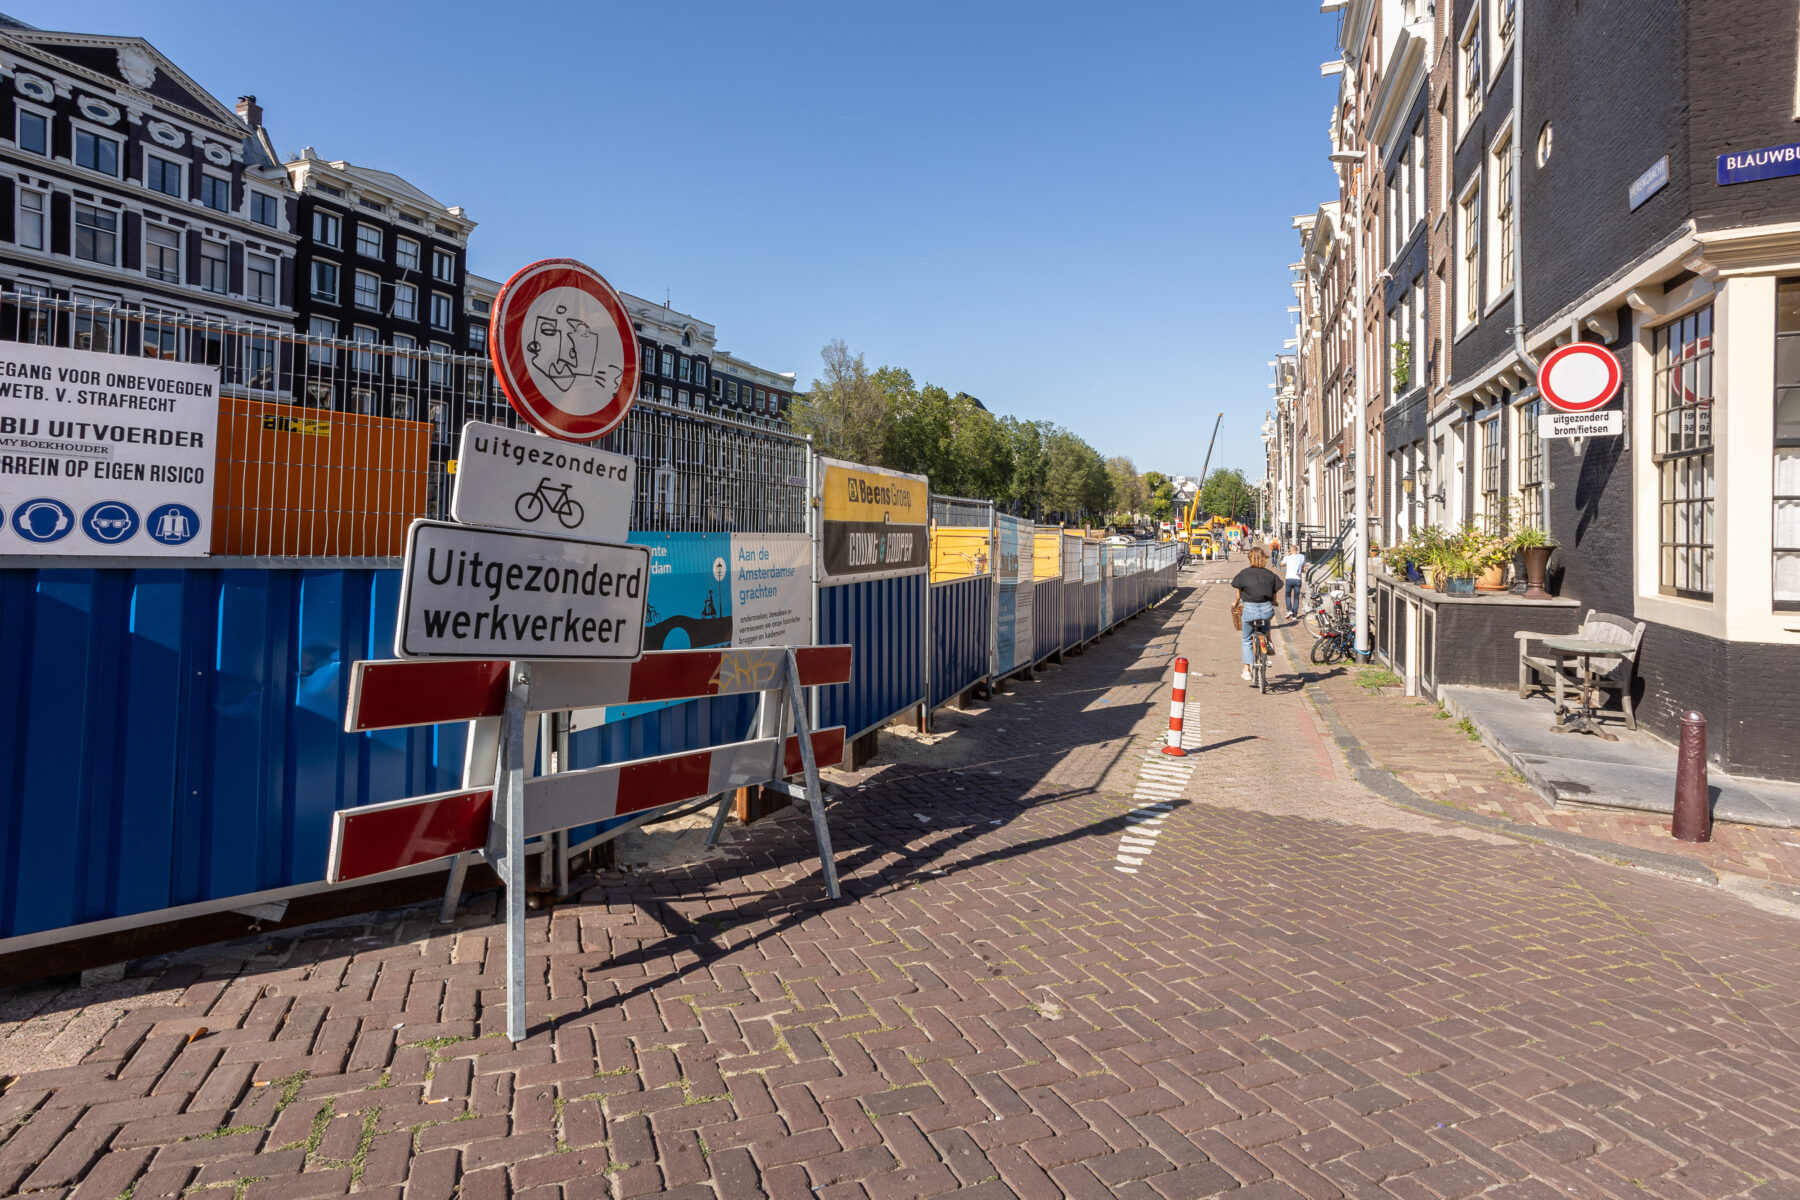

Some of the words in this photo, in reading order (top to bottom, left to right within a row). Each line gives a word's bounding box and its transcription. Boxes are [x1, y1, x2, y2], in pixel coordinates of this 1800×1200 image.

[1726, 146, 1800, 170] BLAUWB
[58, 367, 100, 386] VOOR
[106, 373, 213, 398] ONBEVOEGDEN
[0, 382, 49, 401] WETB.
[77, 390, 177, 413] STRAFRECHT
[0, 416, 39, 436] BIJ
[48, 420, 204, 448] UITVOERDER
[1553, 412, 1609, 425] uitgezonderd
[20, 440, 109, 454] BOEKHOUDER
[474, 436, 628, 482] uitgezonderd
[1, 455, 59, 476] RREIN
[65, 459, 89, 478] OP
[94, 461, 145, 481] EIGEN
[150, 464, 204, 484] RISICO
[738, 547, 756, 561] Aan
[758, 546, 769, 560] de
[427, 547, 641, 601] Uitgezonderd
[738, 564, 795, 581] Amsterdamse
[739, 584, 777, 605] grachten
[423, 604, 626, 643] werkverkeer
